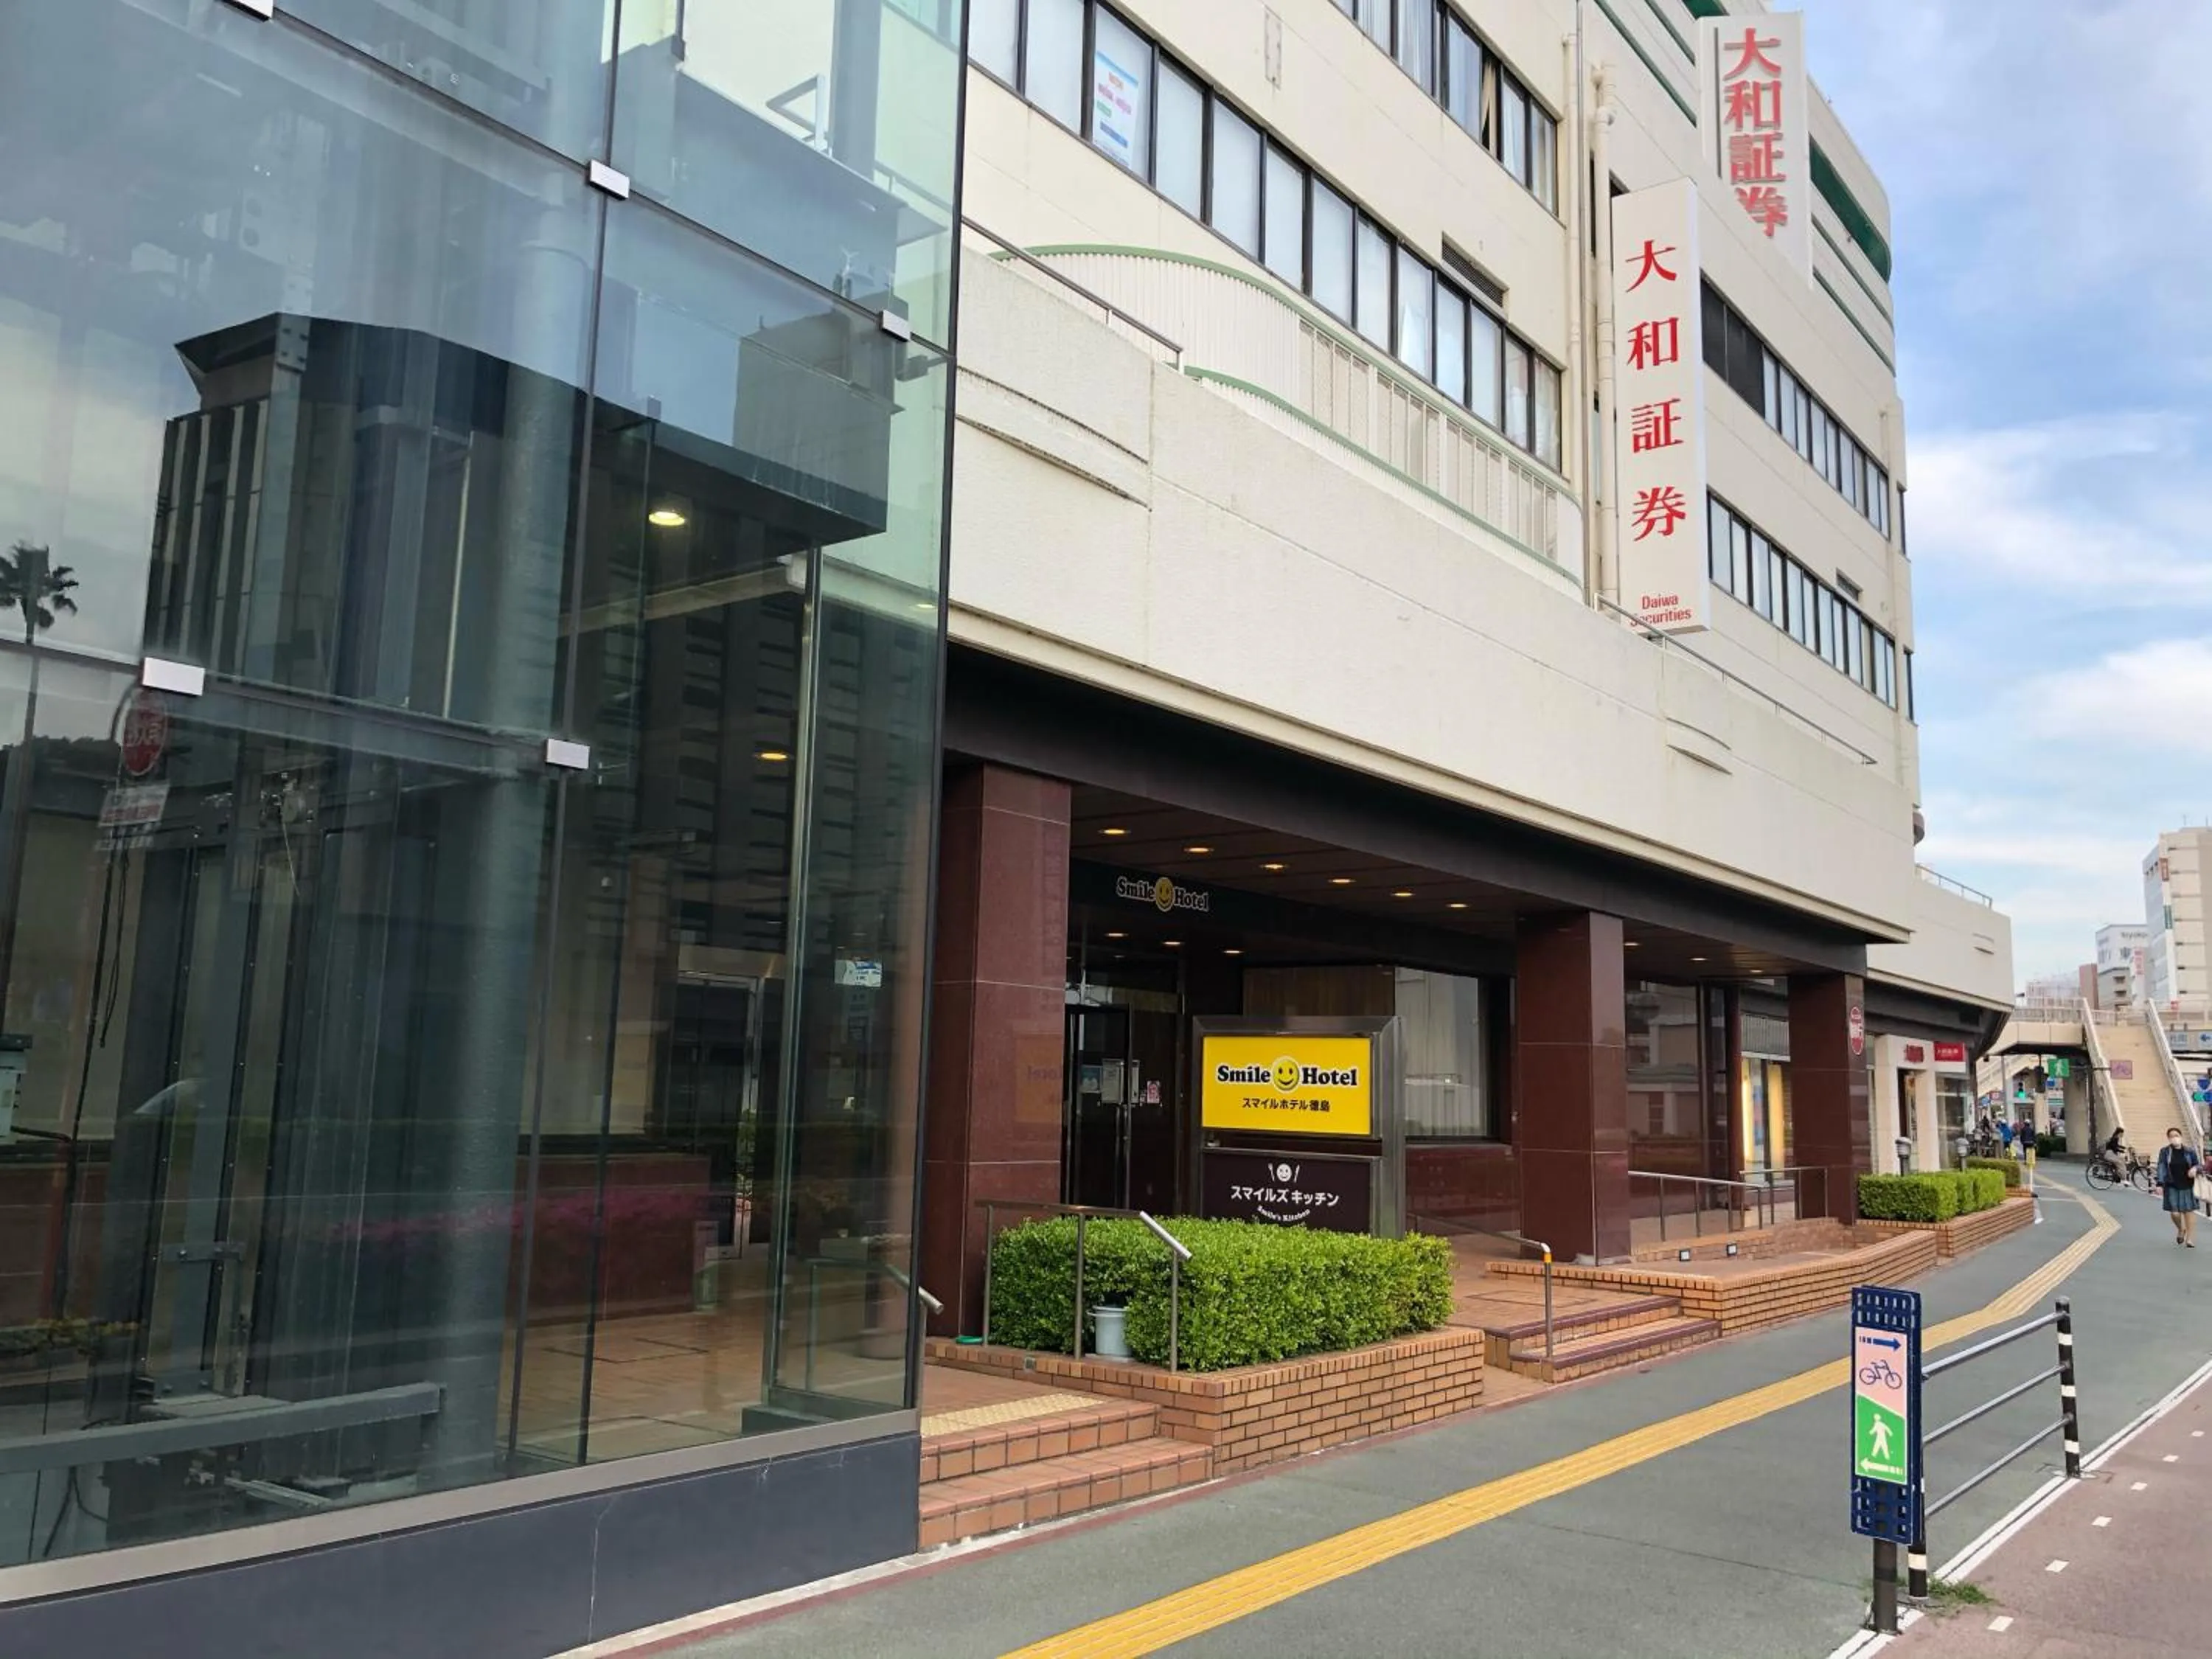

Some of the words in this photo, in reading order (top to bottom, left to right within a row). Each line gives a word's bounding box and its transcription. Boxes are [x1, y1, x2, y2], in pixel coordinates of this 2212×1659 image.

[1723, 27, 1788, 238] 大和証券
[1625, 239, 1687, 542] 大和証券
[1641, 593, 1679, 610] Daiwa
[1116, 875, 1157, 902] Smile
[1173, 886, 1209, 912] Hotel
[1217, 1065, 1271, 1083] Smile
[1301, 1067, 1357, 1086] Hotel
